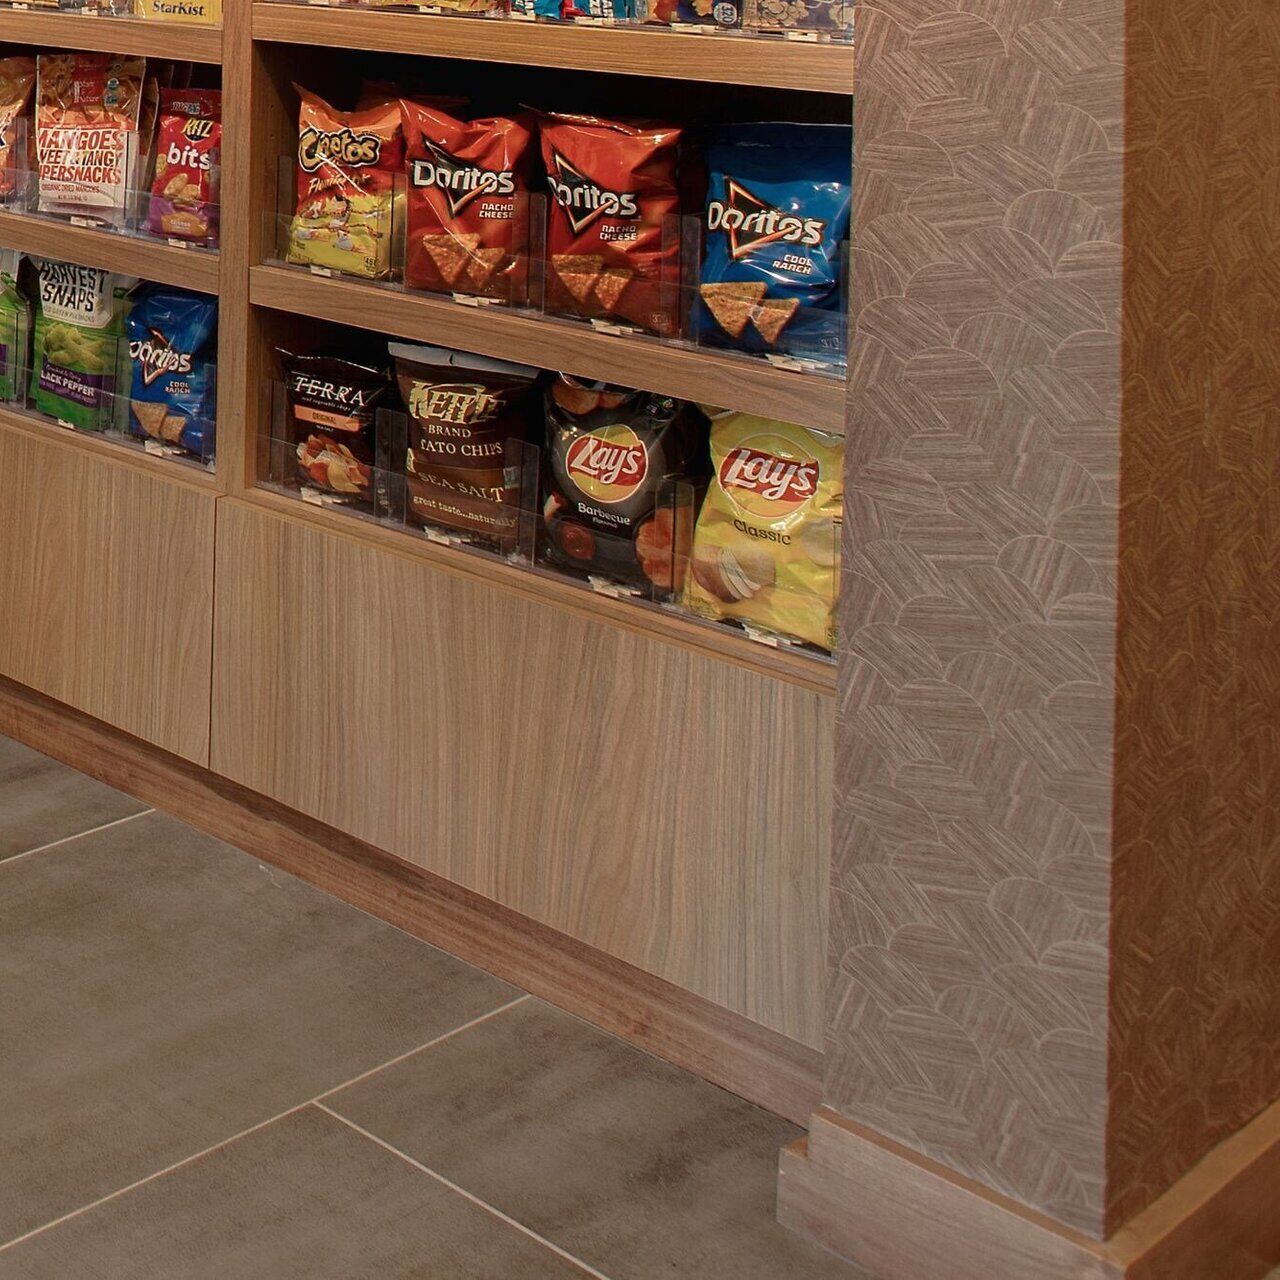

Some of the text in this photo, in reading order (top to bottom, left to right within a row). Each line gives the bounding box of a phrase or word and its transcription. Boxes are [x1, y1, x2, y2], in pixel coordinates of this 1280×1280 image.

[152, 0, 206, 17] StarKist
[721, 5, 735, 25] 320
[180, 117, 215, 138] RITZ
[166, 141, 211, 170] bits
[411, 159, 515, 195] Doritos
[481, 202, 514, 211] NACHO
[547, 176, 638, 217] Doritos
[479, 210, 514, 219] CHEESE
[706, 201, 825, 246] Doritos
[599, 232, 639, 241] CHEESE
[601, 224, 637, 234] NACHO
[771, 260, 813, 275] RANCH
[783, 254, 813, 266] COOL
[40, 262, 110, 294] HARVEST
[42, 283, 95, 312] SNAPS
[129, 341, 191, 373] Doritos
[63, 378, 95, 397] PEPPER
[293, 376, 367, 407] TERRA
[427, 423, 472, 438] BRAND
[461, 442, 503, 458] CHIPS
[570, 437, 642, 485] Lay's
[723, 449, 818, 501] Lay's
[420, 471, 506, 504] SEA SALT
[413, 494, 437, 510] great
[577, 502, 631, 526] Barbecue
[733, 518, 791, 547] Classic
